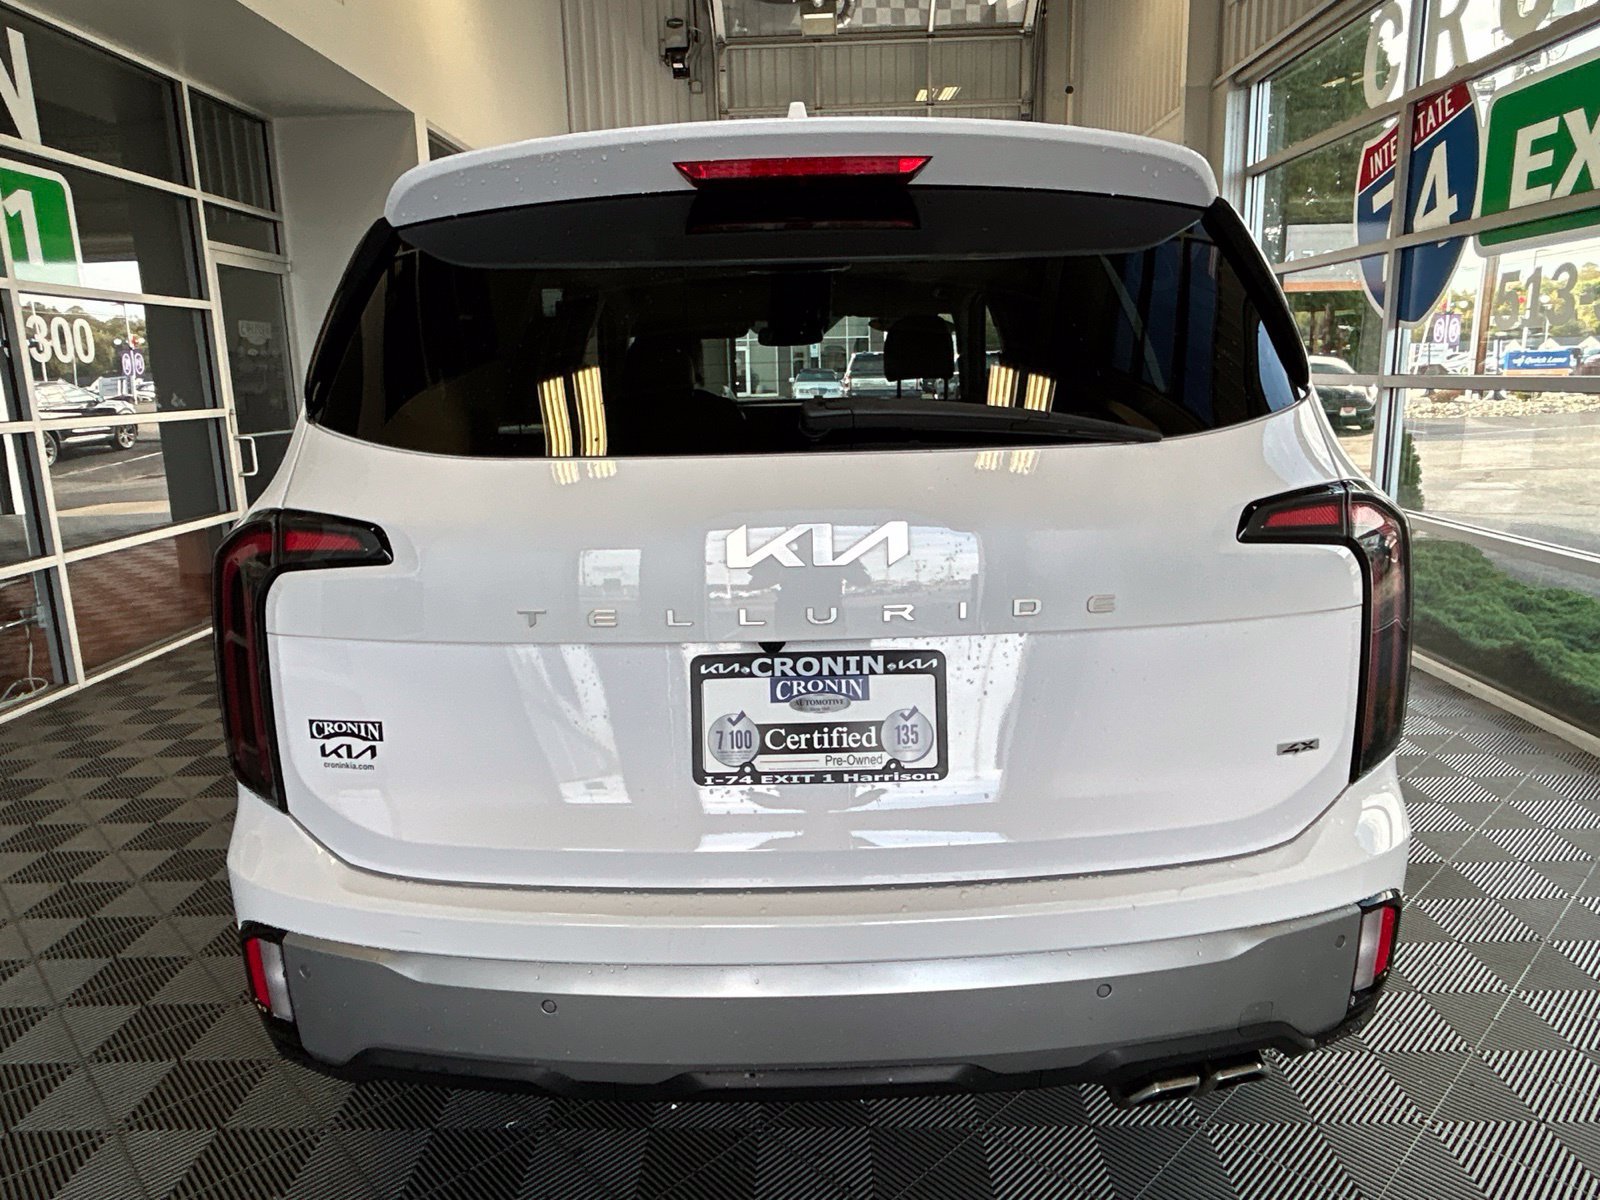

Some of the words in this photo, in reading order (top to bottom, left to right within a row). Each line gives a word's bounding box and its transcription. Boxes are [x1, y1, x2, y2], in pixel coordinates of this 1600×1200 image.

[1369, 89, 1455, 179] INTETATE
[726, 521, 909, 569] KIA
[517, 594, 1115, 629] TELLURIDE
[751, 655, 884, 678] CRONIN
[776, 679, 864, 700] CRONIN
[794, 699, 845, 707] AUTOMOTIVE
[312, 721, 380, 740] CRONIN
[716, 730, 723, 749] 7
[729, 730, 752, 749] 100
[764, 726, 878, 750] Certified
[895, 724, 919, 746] 135
[320, 743, 377, 760] KIA
[825, 754, 883, 766] Pre-Owned
[323, 762, 375, 771] croninkia.com
[704, 775, 754, 785] I-74
[761, 774, 815, 784] EXIT
[823, 773, 835, 783] 1
[843, 771, 939, 782] Harrison
